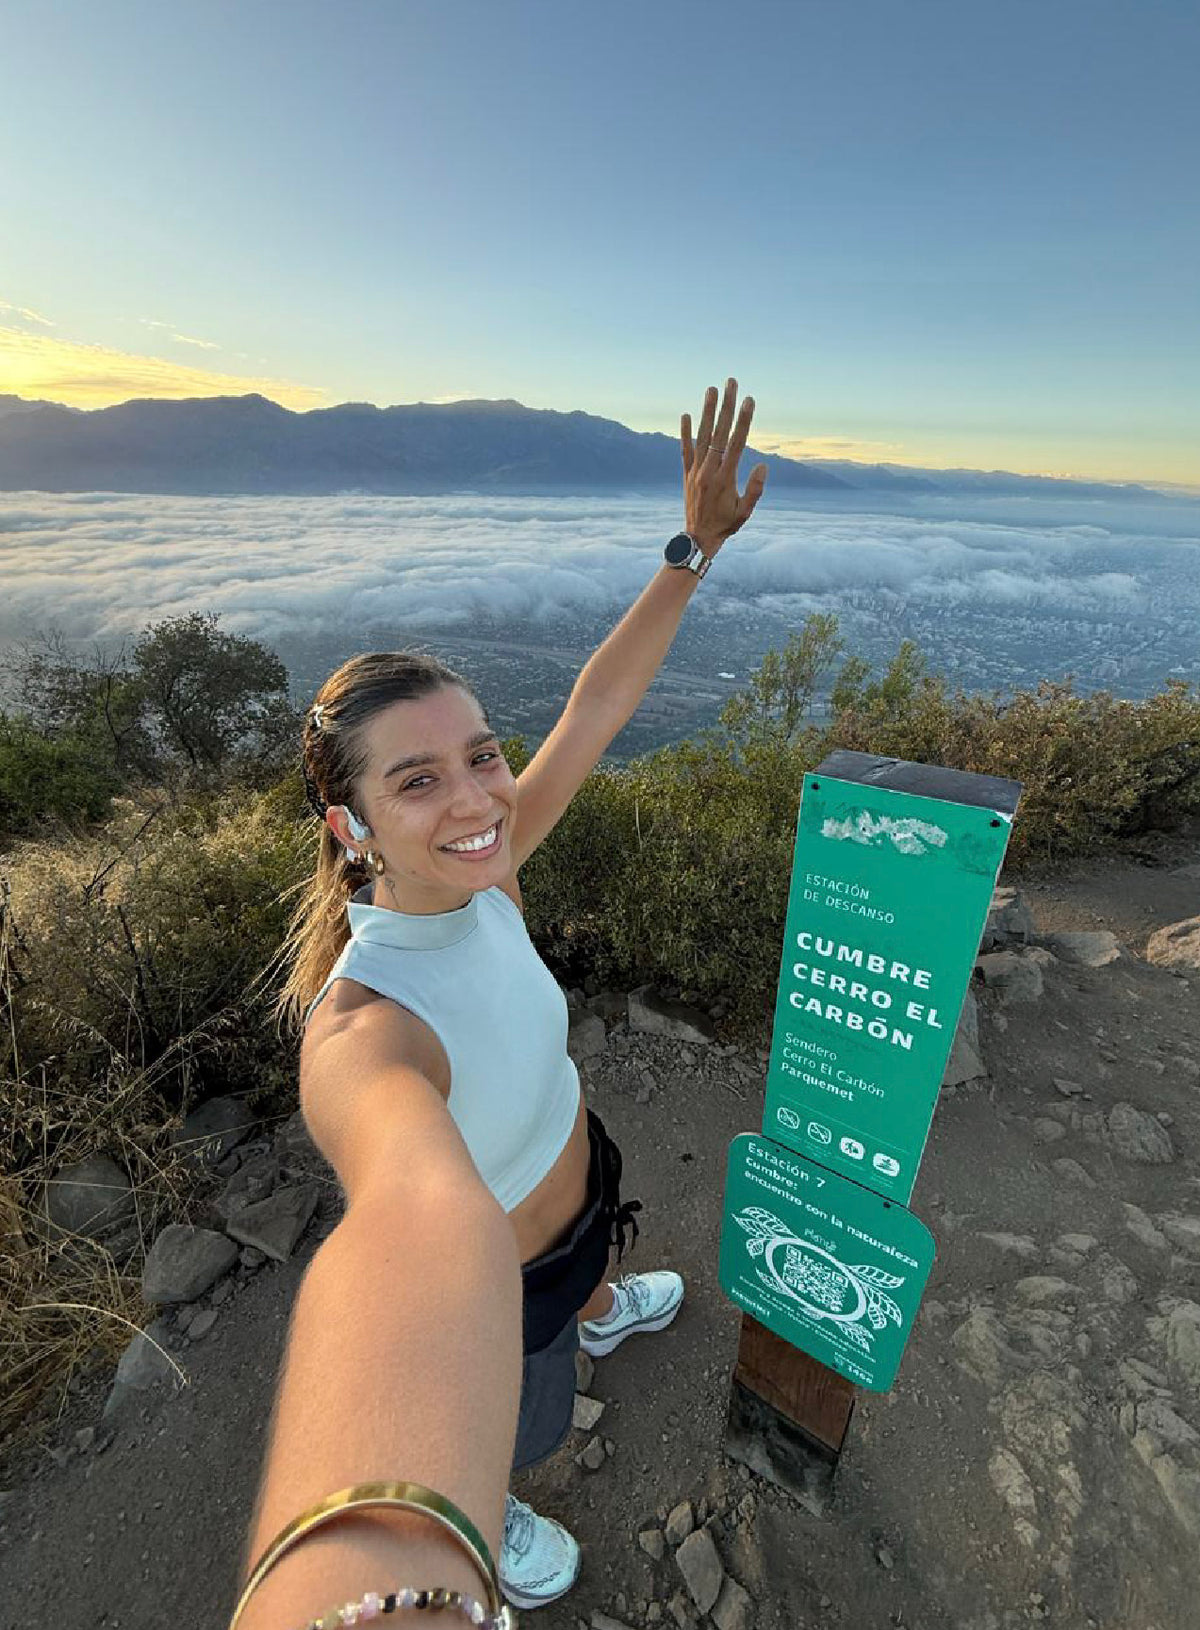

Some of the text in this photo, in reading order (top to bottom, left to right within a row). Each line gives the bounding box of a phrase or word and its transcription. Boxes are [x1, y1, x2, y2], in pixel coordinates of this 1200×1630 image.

[803, 888, 894, 924] DE DESCANSO
[806, 874, 870, 900] ESTACIÓN
[797, 932, 932, 990] CUMBRE
[793, 963, 942, 1029] CERRO EL
[789, 991, 914, 1050] CARBÓN
[785, 1032, 837, 1060] Sendero
[781, 1062, 854, 1102] Parquemet
[782, 1047, 885, 1098] Cerro El Carbón
[748, 1142, 810, 1182] Estación
[816, 1177, 826, 1188] 7
[744, 1170, 919, 1269] encuentro con la naturaleza
